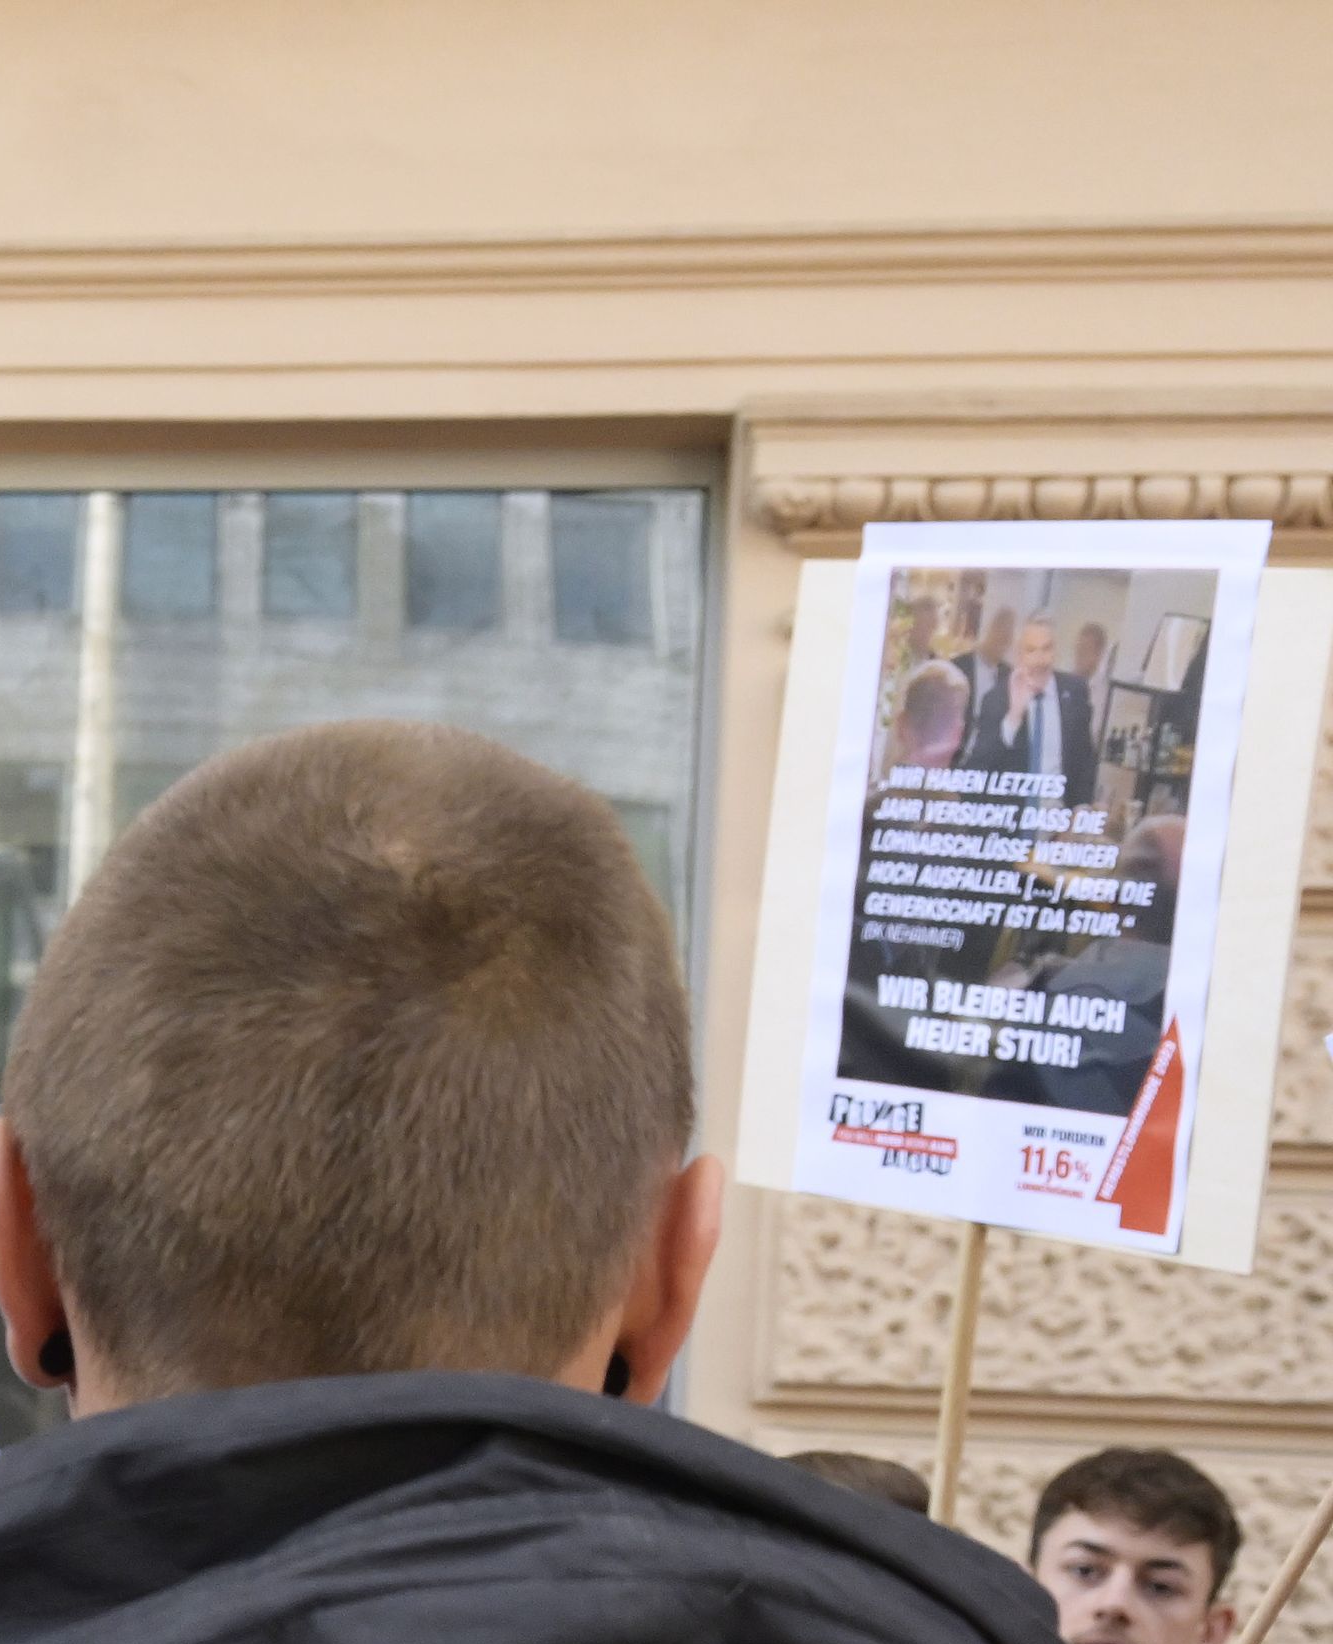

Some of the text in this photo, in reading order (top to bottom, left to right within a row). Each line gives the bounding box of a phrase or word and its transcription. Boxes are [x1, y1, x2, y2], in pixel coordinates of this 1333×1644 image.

[986, 771, 1067, 799] LETZTES
[873, 797, 924, 821] JAHR
[1019, 806, 1072, 832] DASS
[1072, 811, 1108, 834] DIE
[1032, 840, 1119, 868] WENIGER
[867, 860, 918, 885] HOCH
[1063, 876, 1119, 903] ABER
[1119, 880, 1157, 907] DIE
[864, 892, 1006, 926] GEWERKSCHAFT
[1004, 904, 1039, 928] IST
[1036, 908, 1065, 932] DA
[877, 974, 1127, 1034] WIR BLEIBEN AUCH
[904, 1016, 1082, 1069] HEUER STUR!
